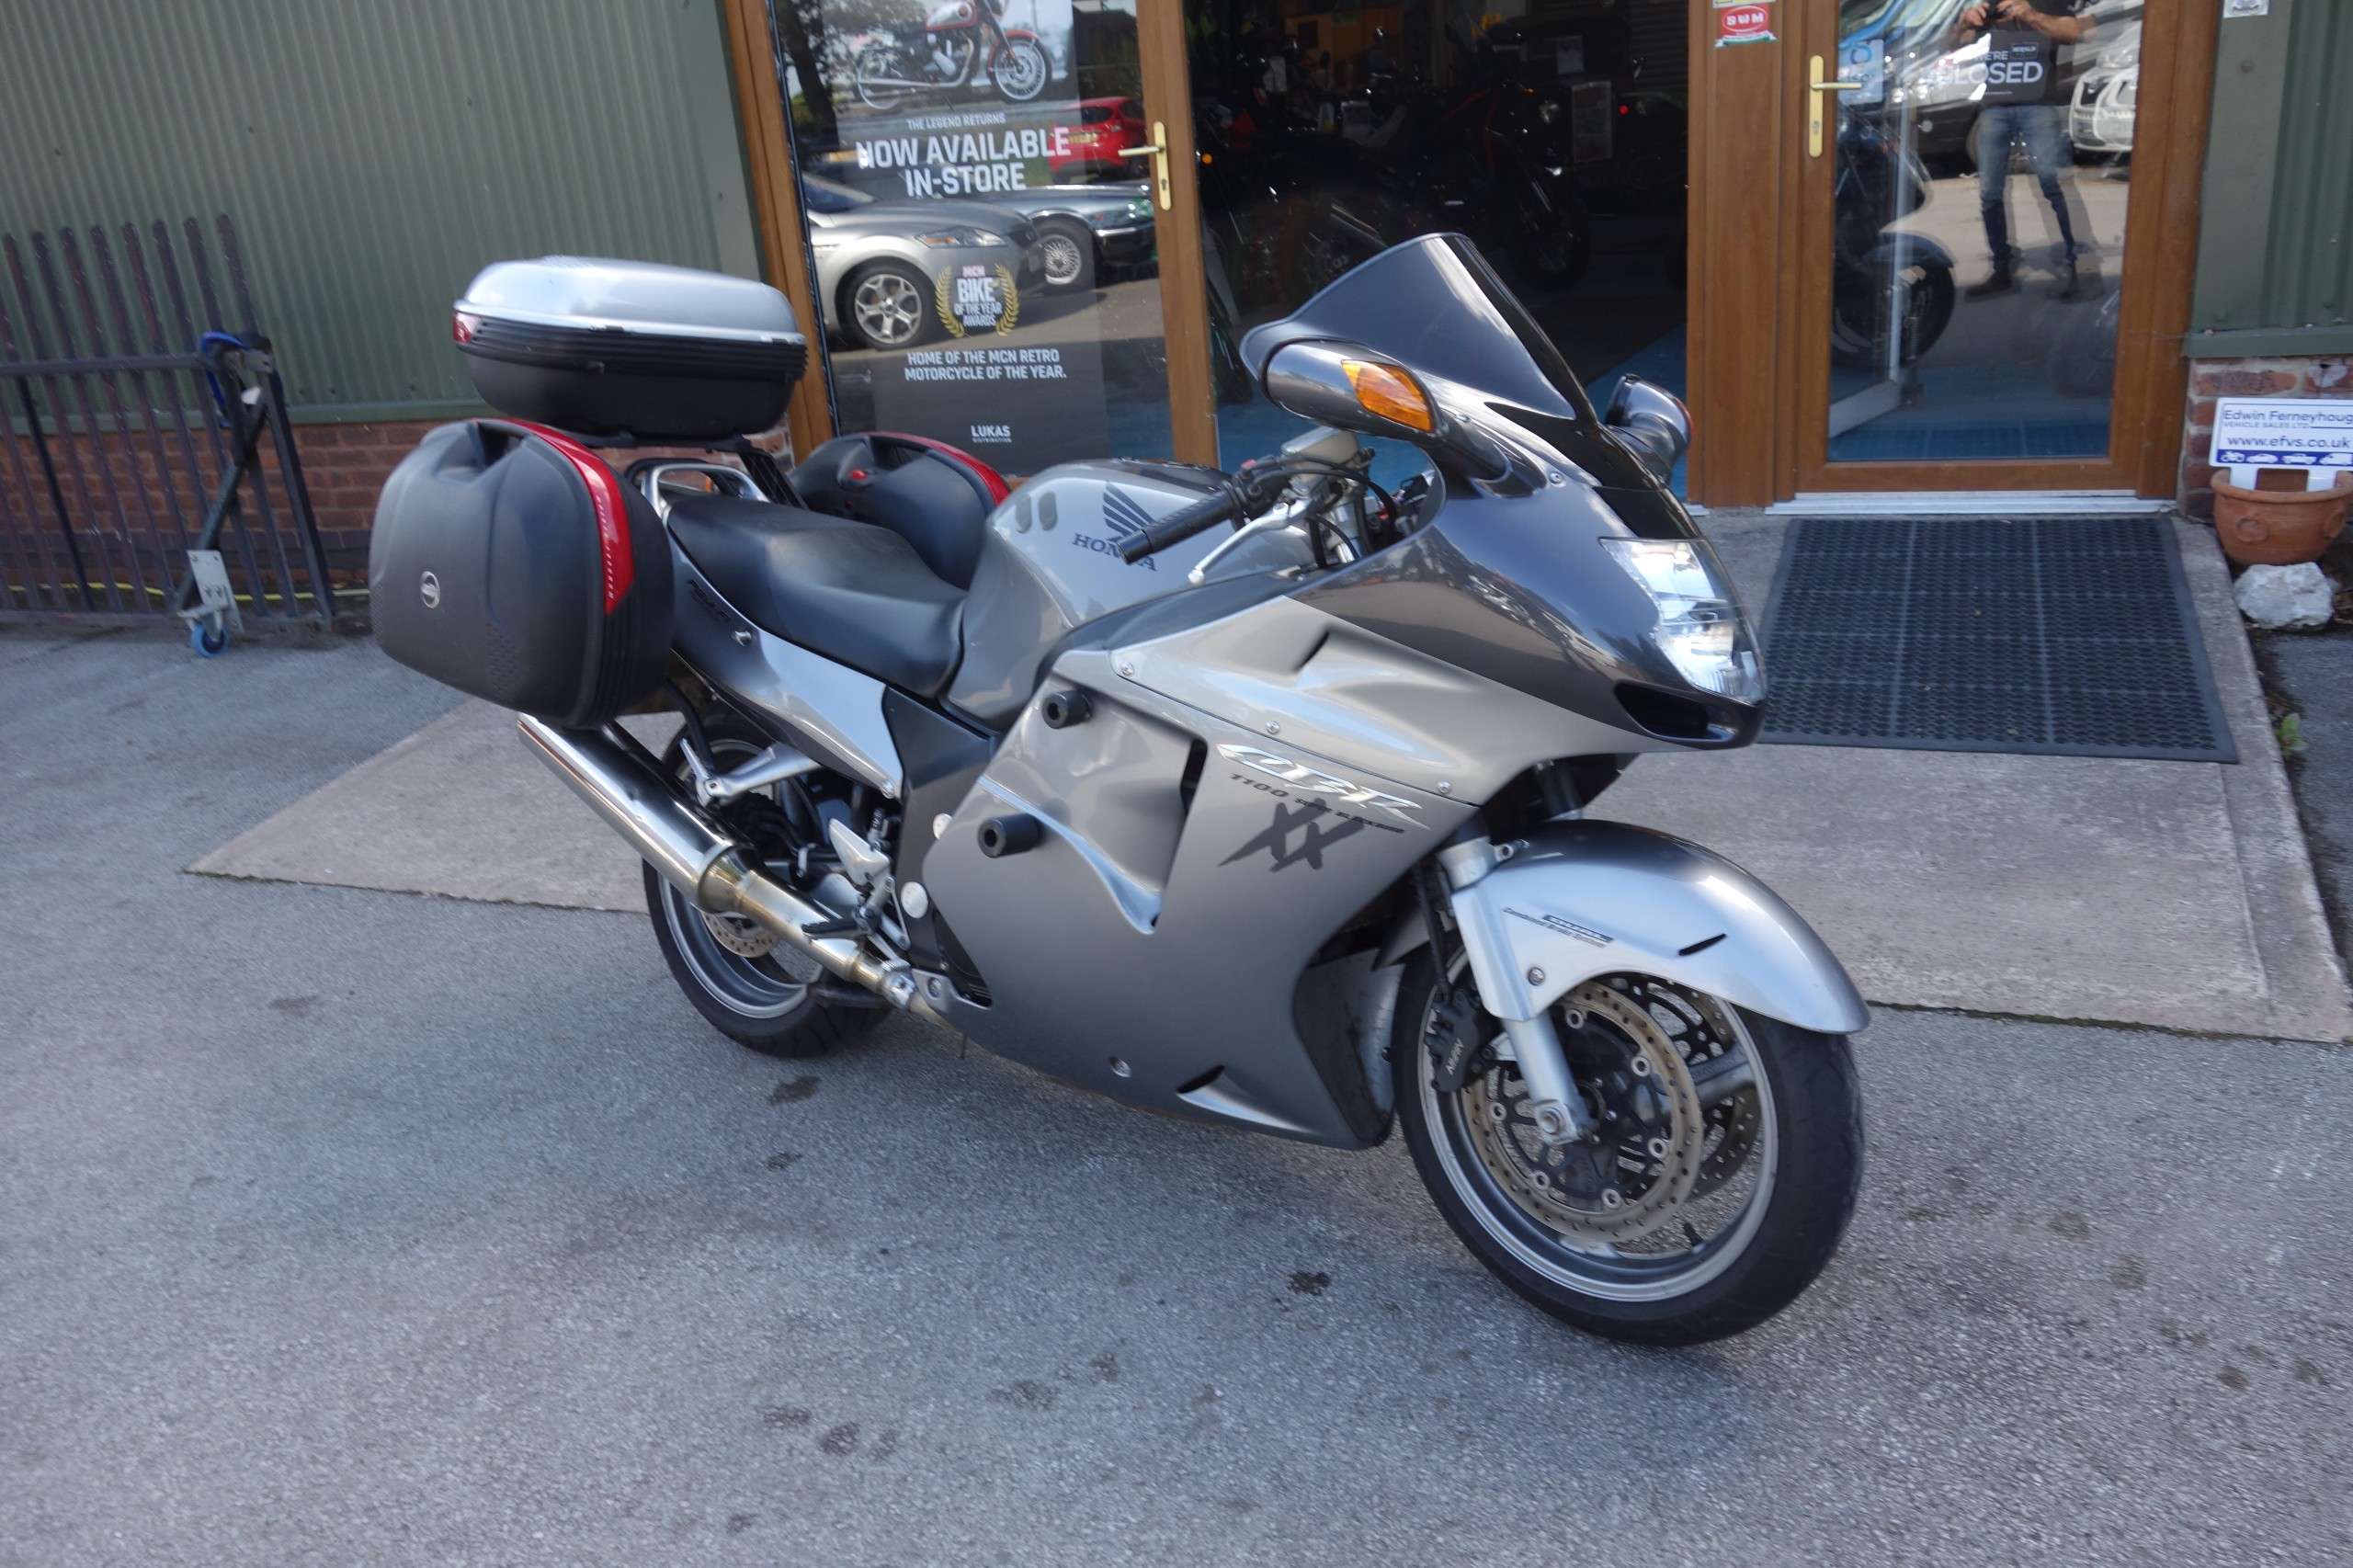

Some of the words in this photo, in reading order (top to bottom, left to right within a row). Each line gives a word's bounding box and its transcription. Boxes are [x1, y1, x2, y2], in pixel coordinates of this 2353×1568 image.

[906, 118, 924, 131] THE
[926, 116, 962, 129] LEGEND
[964, 112, 1006, 127] RETURNS
[856, 138, 919, 169] NOW
[926, 127, 1072, 165] AVAILABLE
[904, 162, 1027, 198] IN-STORE
[957, 278, 996, 303] BIKE
[965, 303, 980, 315] THE
[980, 301, 1003, 314] YEAR
[962, 314, 996, 327] AWARDS
[907, 350, 943, 366] HOME
[945, 350, 962, 365] OF
[963, 350, 986, 365] THE
[988, 349, 1017, 364] MCN
[1019, 348, 1060, 363] RETRO
[904, 367, 985, 381] MOTORCYCLE
[986, 366, 1004, 380] OF
[1005, 365, 1028, 380] THE
[1029, 365, 1066, 379] YEAR.
[2224, 410, 2265, 420] Edwin
[971, 425, 1011, 437] LUKAS
[2227, 436, 2350, 449] www.efvs.co.uk
[1072, 533, 1157, 572] HONA
[1229, 773, 1289, 798] 1100
[1217, 797, 1365, 872] XX
